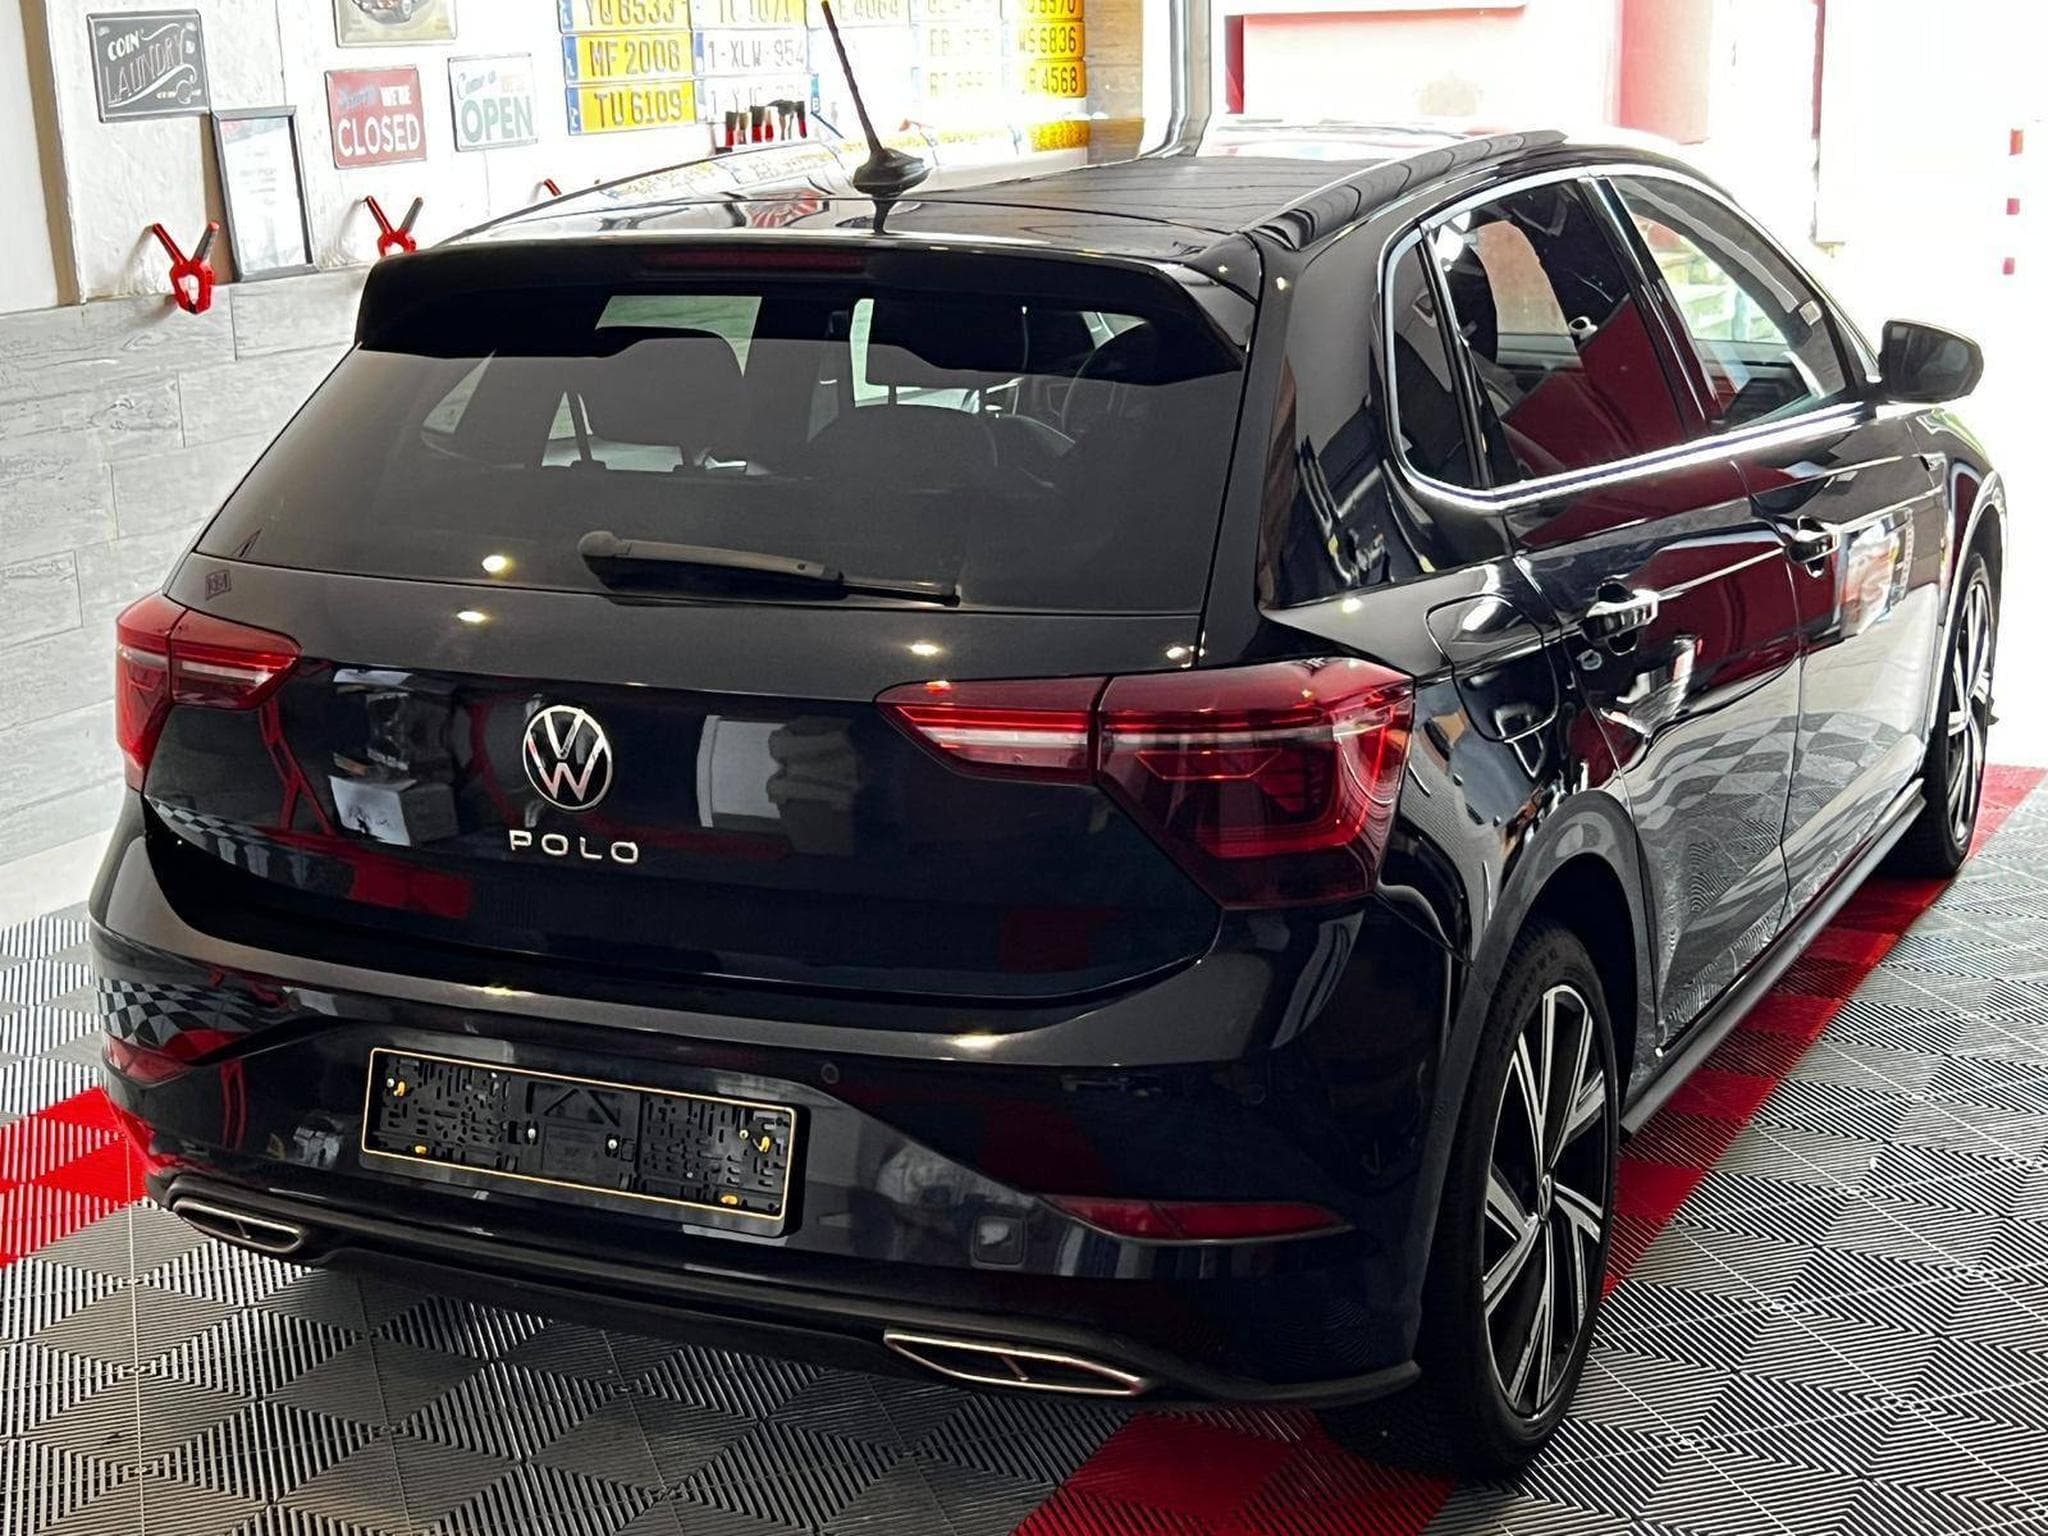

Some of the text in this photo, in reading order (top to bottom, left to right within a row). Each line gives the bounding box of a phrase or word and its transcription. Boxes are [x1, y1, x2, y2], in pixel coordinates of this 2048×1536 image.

[589, 40, 619, 77] MF
[624, 39, 681, 75] 2008
[1039, 26, 1077, 53] 6836
[104, 27, 186, 105] LAUNDRY
[1042, 65, 1078, 94] 4568
[461, 96, 535, 143] OPEN
[593, 91, 624, 128] TU
[630, 88, 682, 125] 6109
[337, 113, 421, 158] CLOSED
[509, 829, 639, 863] POLO
